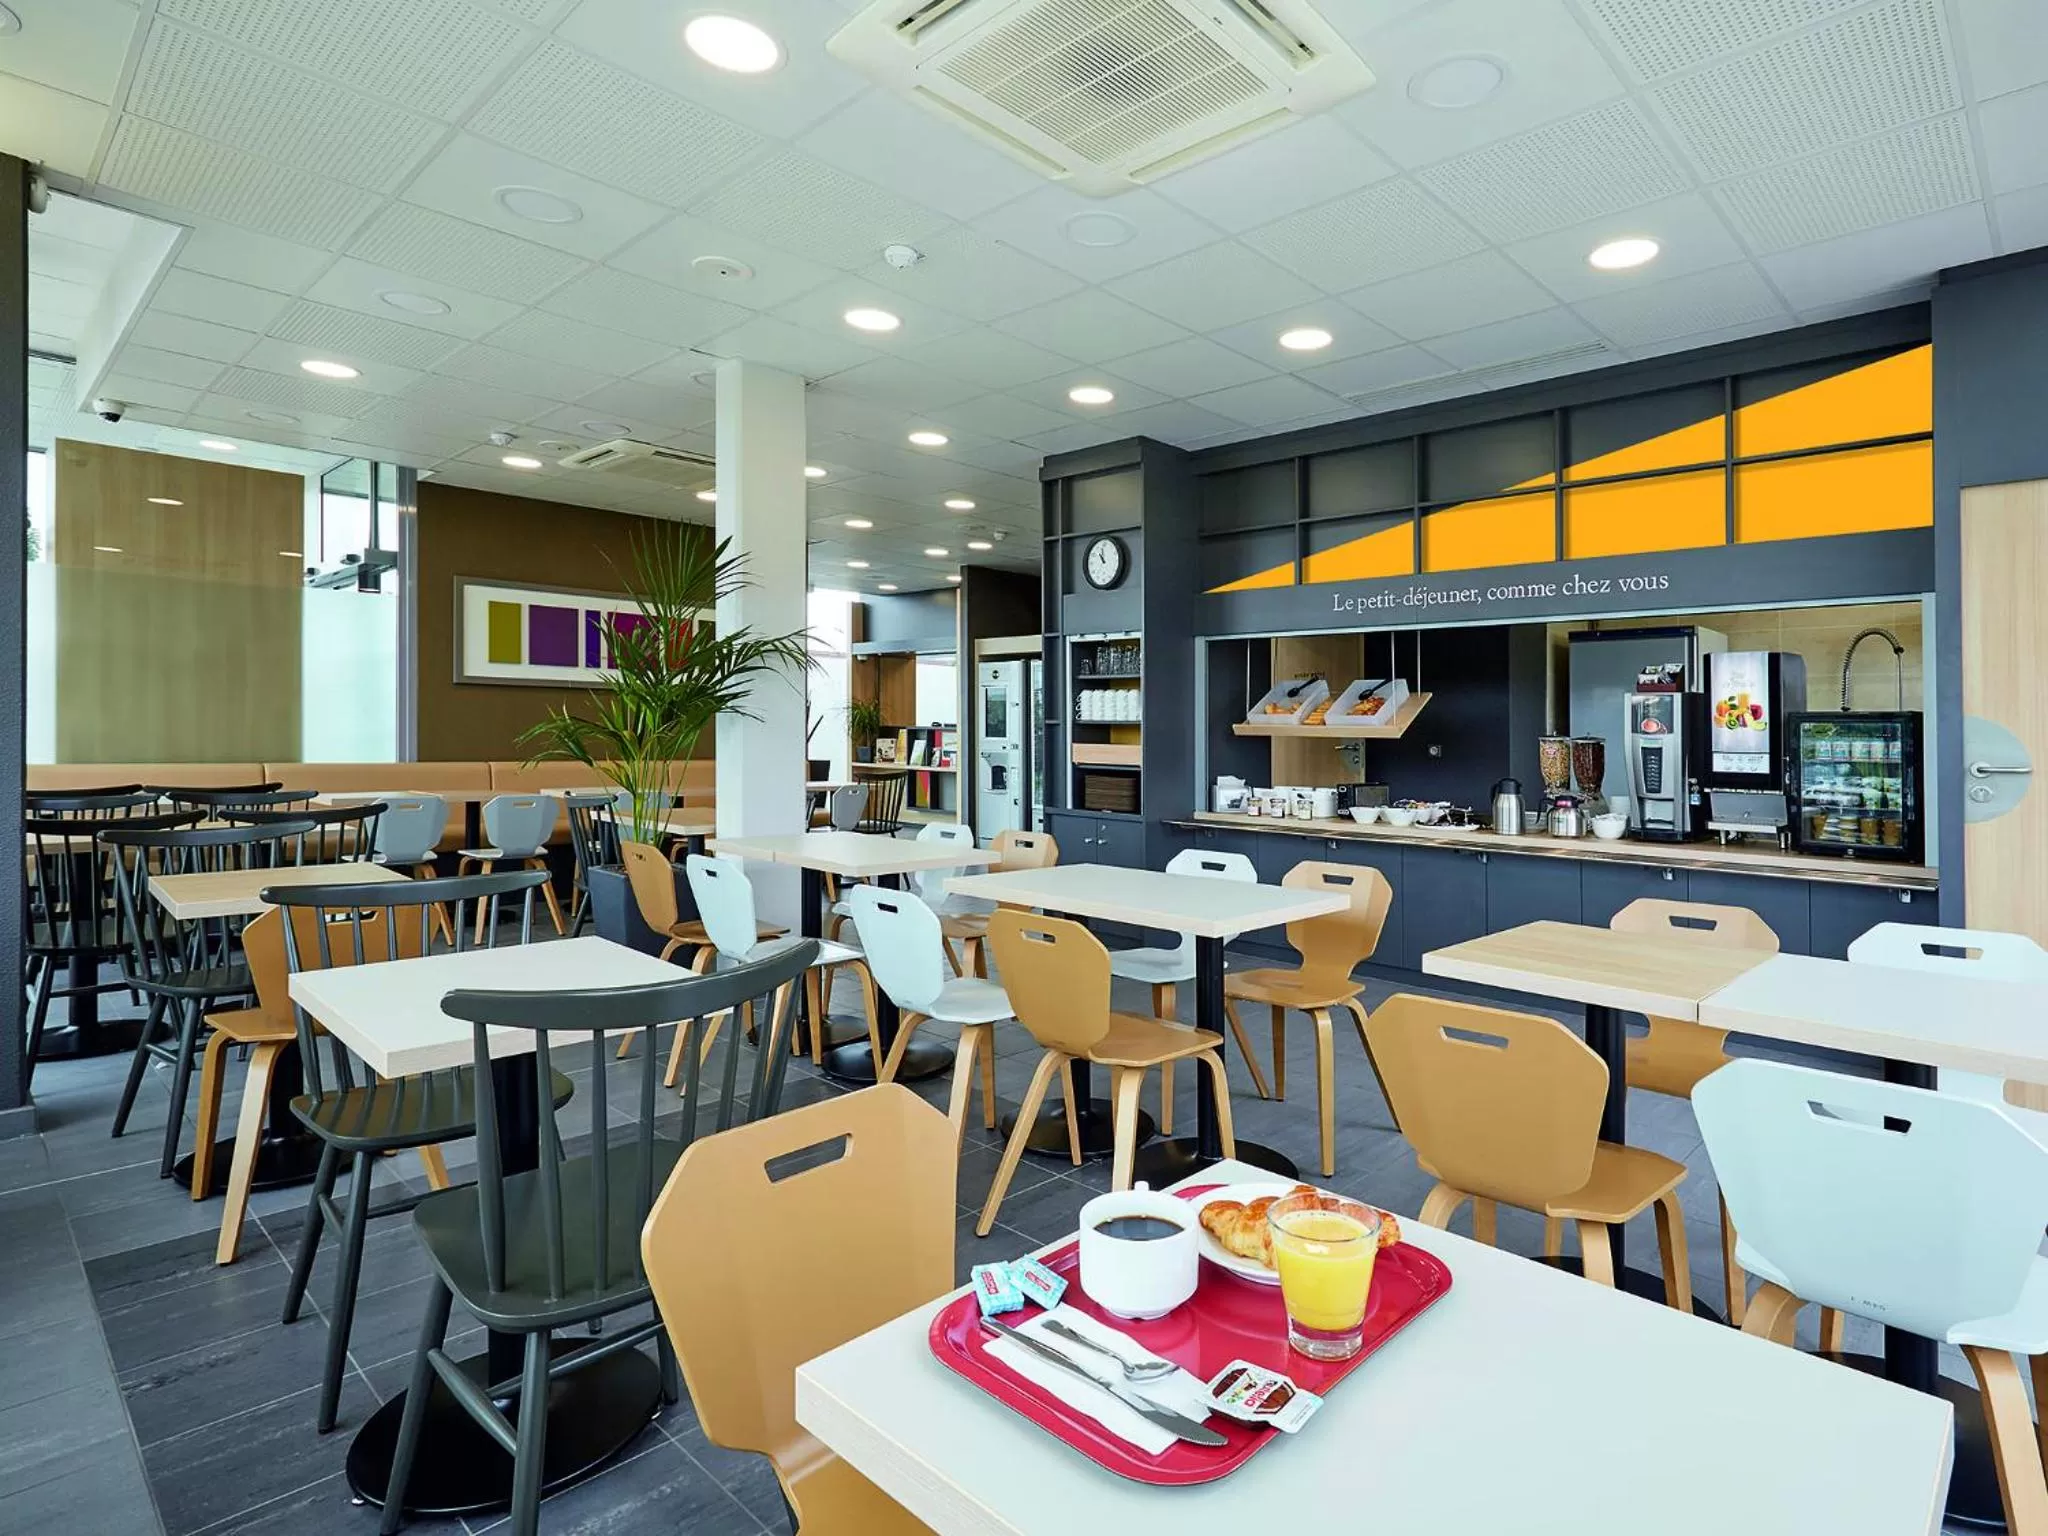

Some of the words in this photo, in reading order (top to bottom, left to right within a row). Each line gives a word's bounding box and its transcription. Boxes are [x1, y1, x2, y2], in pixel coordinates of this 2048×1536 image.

[1333, 593, 1354, 611] Le
[1357, 586, 1482, 614] petit-déjeuner,
[1486, 582, 1557, 600] comme
[1562, 574, 1611, 596] chez
[1618, 574, 1669, 592] vous
